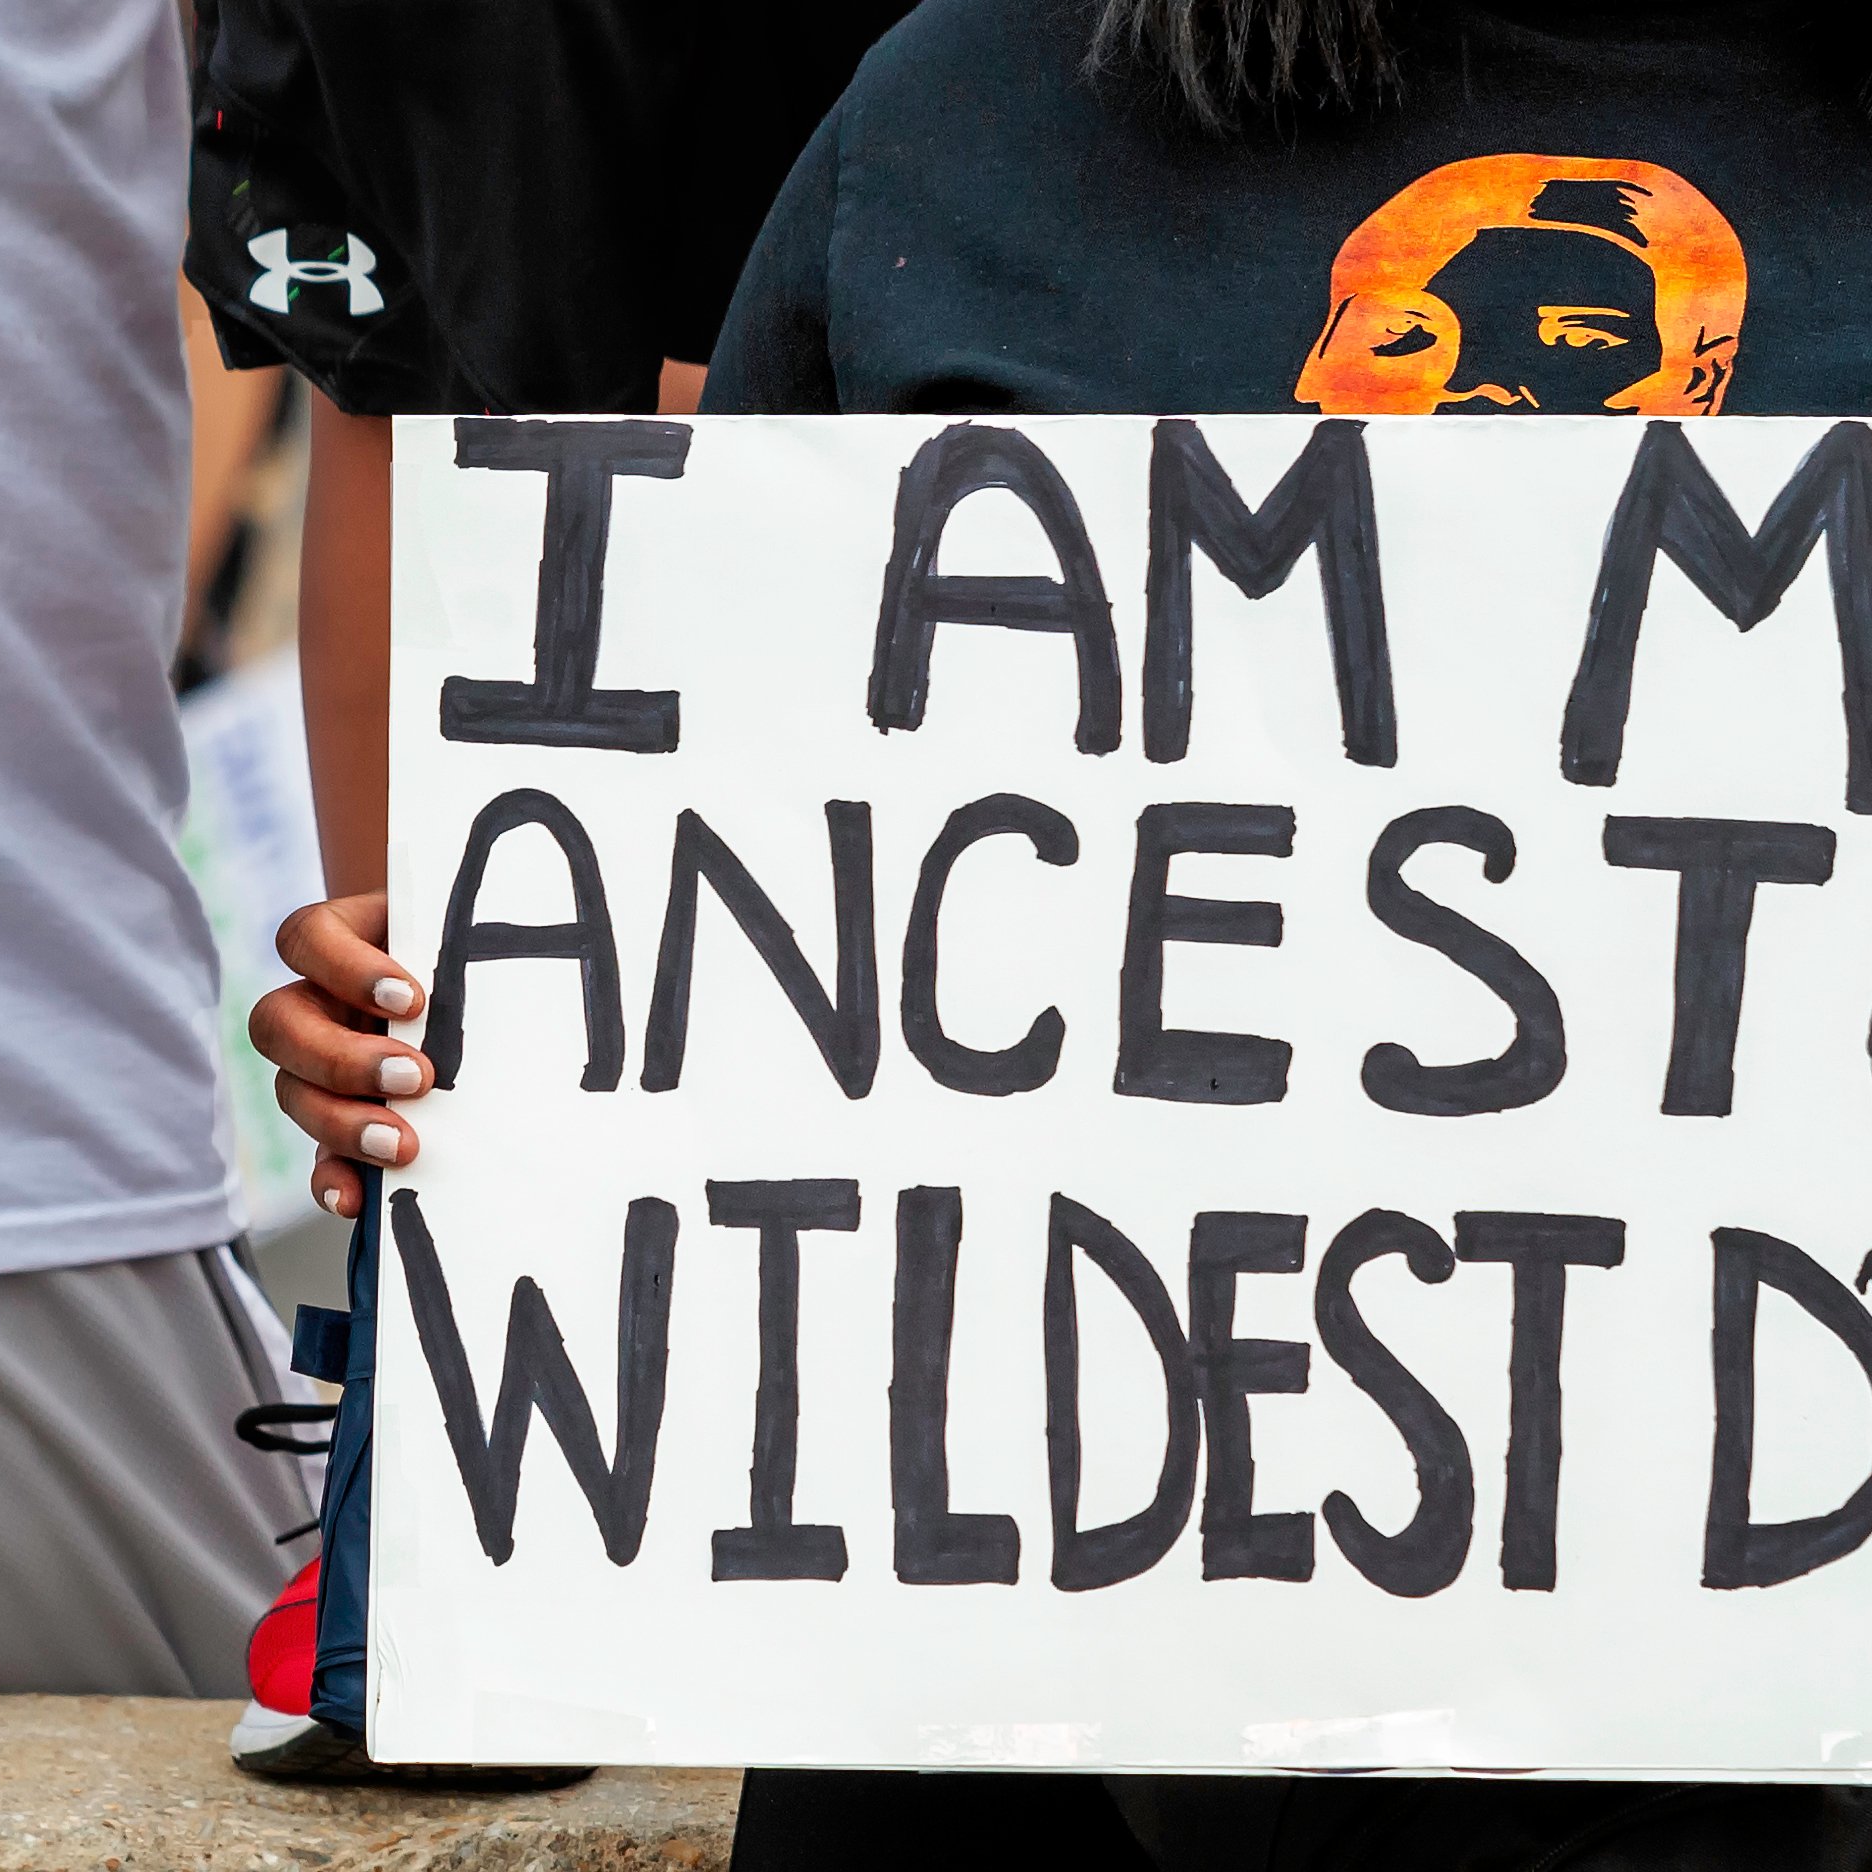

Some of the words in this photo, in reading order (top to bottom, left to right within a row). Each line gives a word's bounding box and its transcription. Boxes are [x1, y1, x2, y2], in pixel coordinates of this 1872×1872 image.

[439, 417, 693, 753] I
[866, 419, 1399, 768] AM
[388, 1178, 1626, 1598] WILDEST
